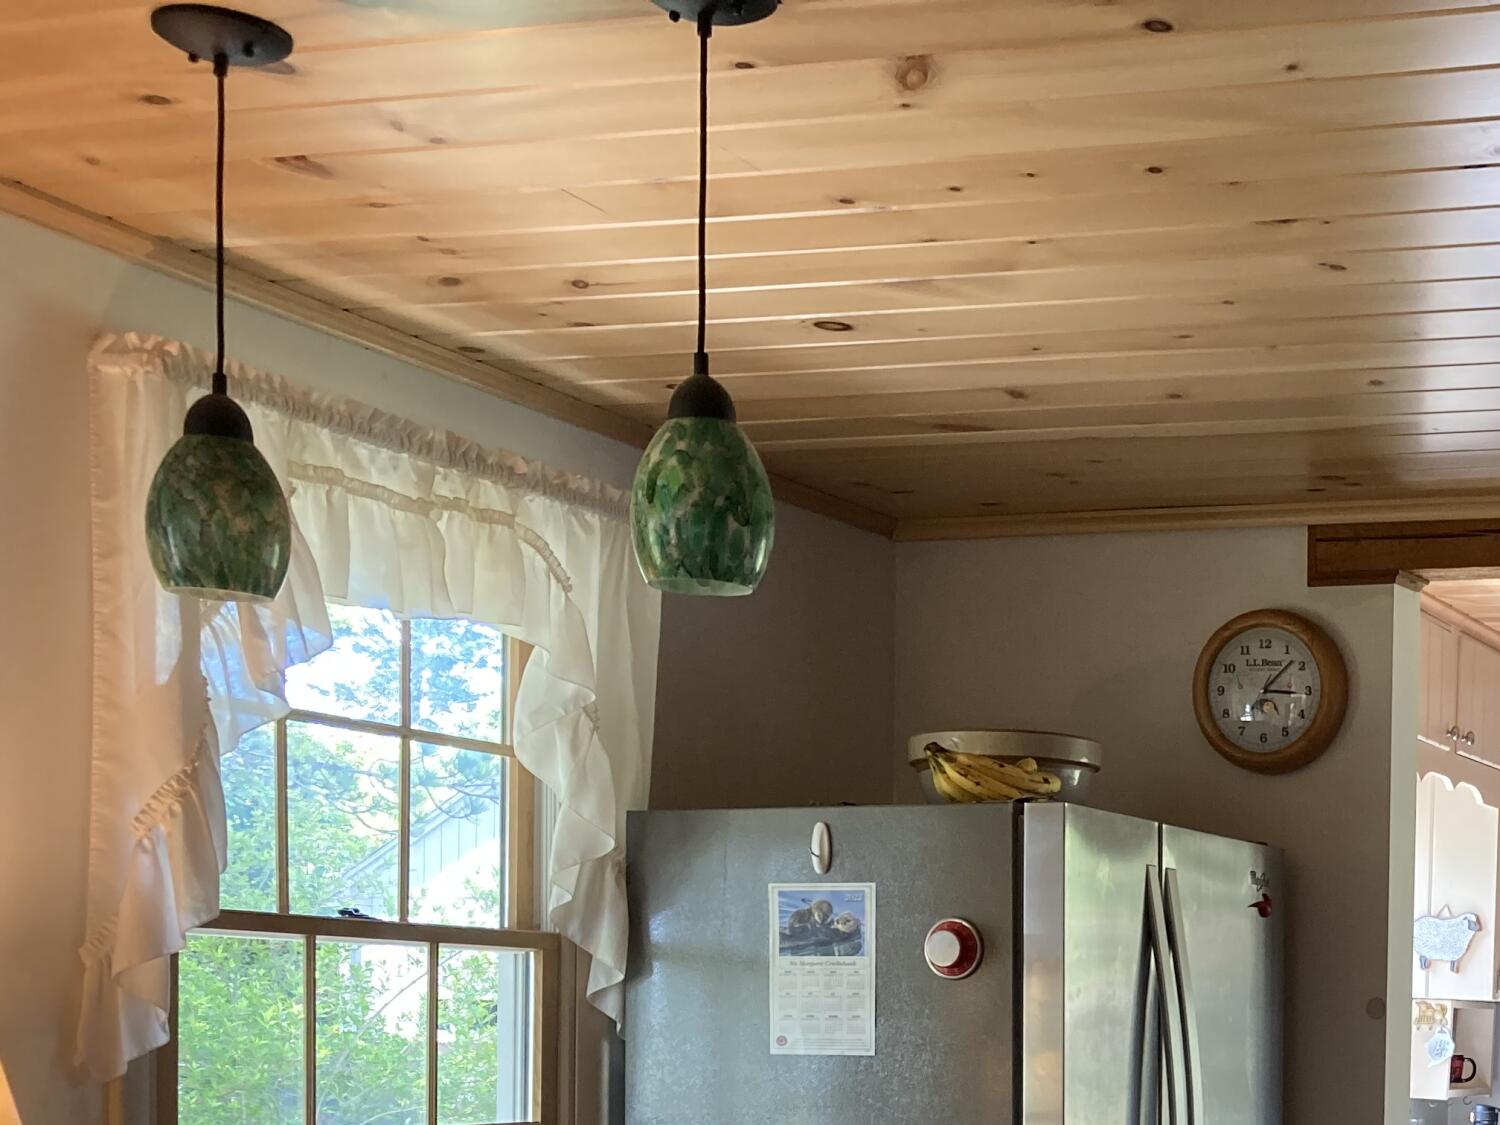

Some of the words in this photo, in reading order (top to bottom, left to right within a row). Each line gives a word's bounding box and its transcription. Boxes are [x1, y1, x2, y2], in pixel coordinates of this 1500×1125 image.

[1259, 639, 1272, 648] 12
[1240, 646, 1251, 655] 11
[1284, 645, 1290, 654] 1
[1223, 663, 1236, 673] 10
[1298, 661, 1306, 671] 2
[1217, 685, 1225, 696] 9
[1305, 685, 1312, 696] 3
[1222, 709, 1230, 718] 8
[1298, 709, 1305, 719] 4
[1238, 726, 1246, 736] 7
[1281, 726, 1289, 737] 5
[1259, 733, 1268, 743] 6
